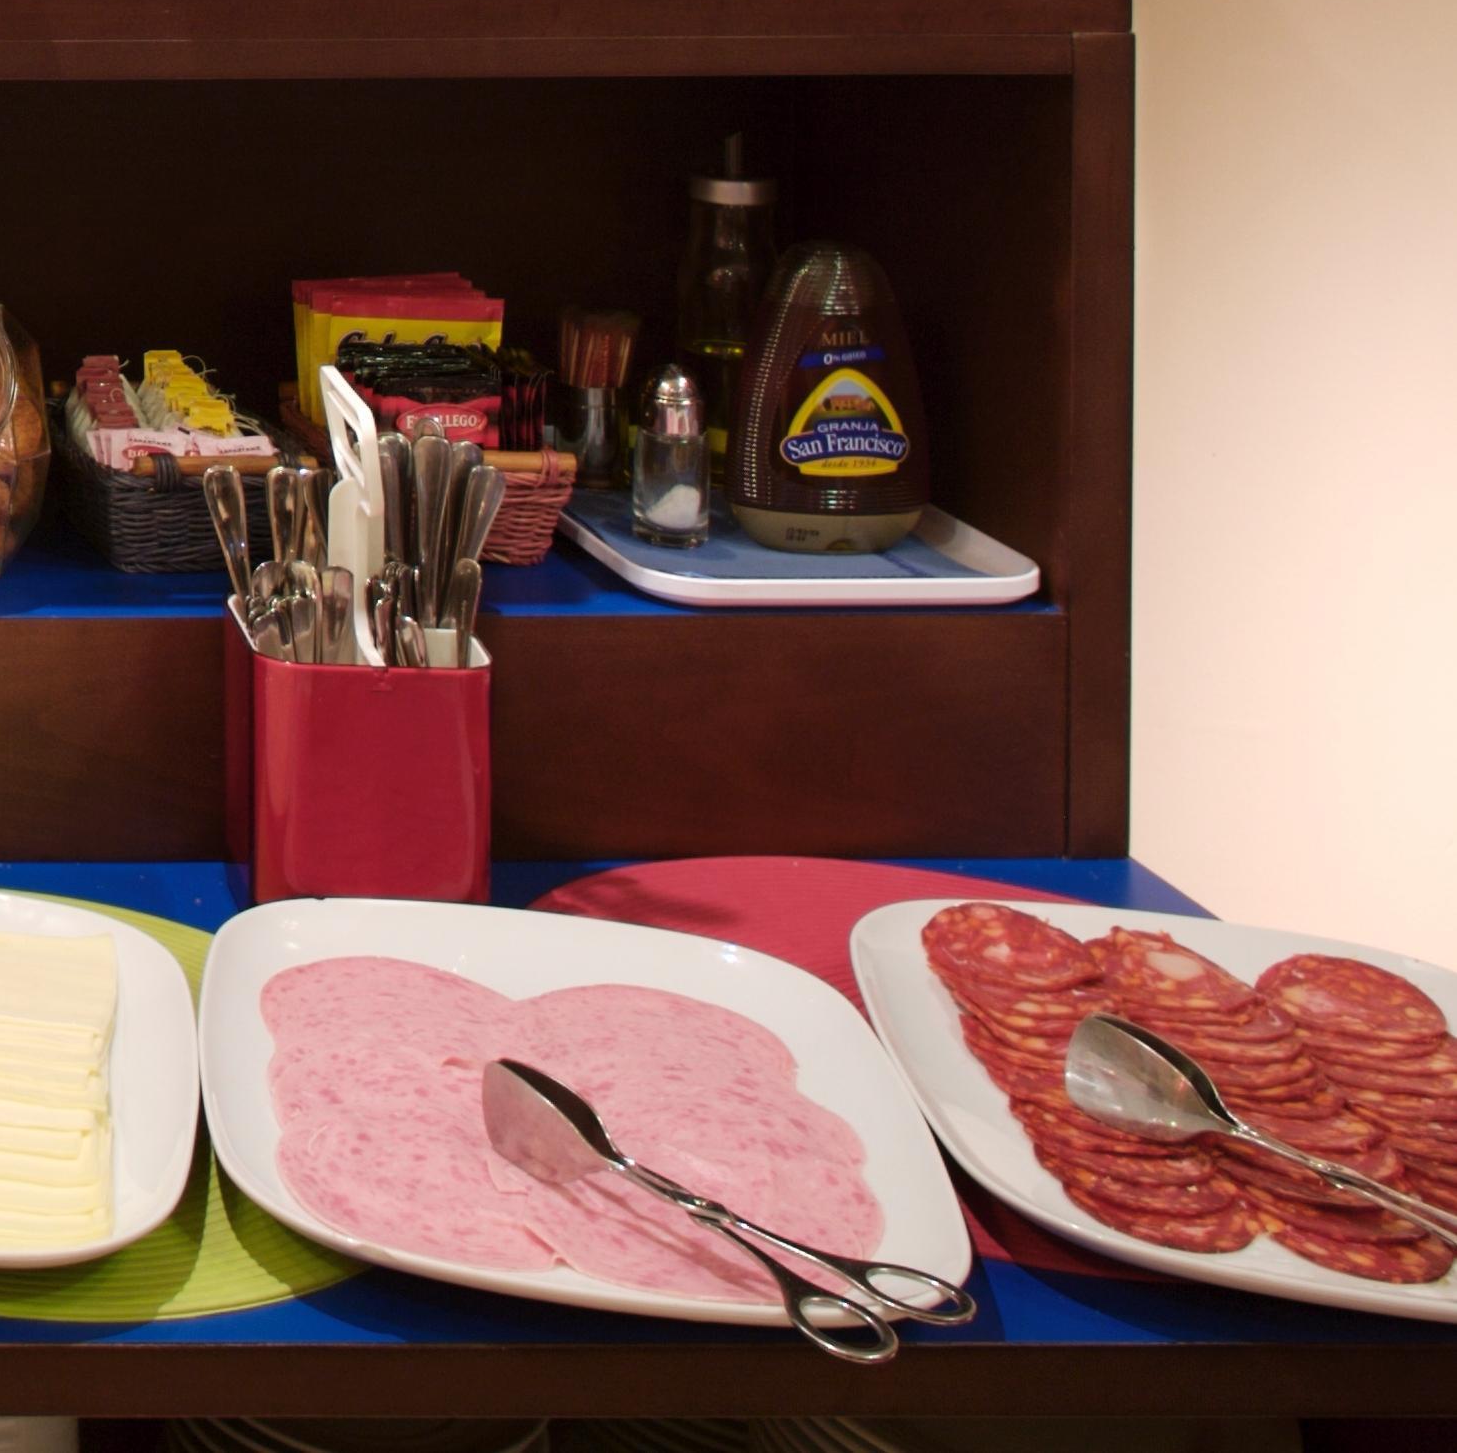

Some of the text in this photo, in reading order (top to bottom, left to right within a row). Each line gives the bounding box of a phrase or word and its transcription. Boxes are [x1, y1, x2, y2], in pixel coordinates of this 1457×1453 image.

[821, 331, 870, 346] MIEL
[817, 421, 879, 433] GRANJA
[787, 432, 903, 460] San Francisco
